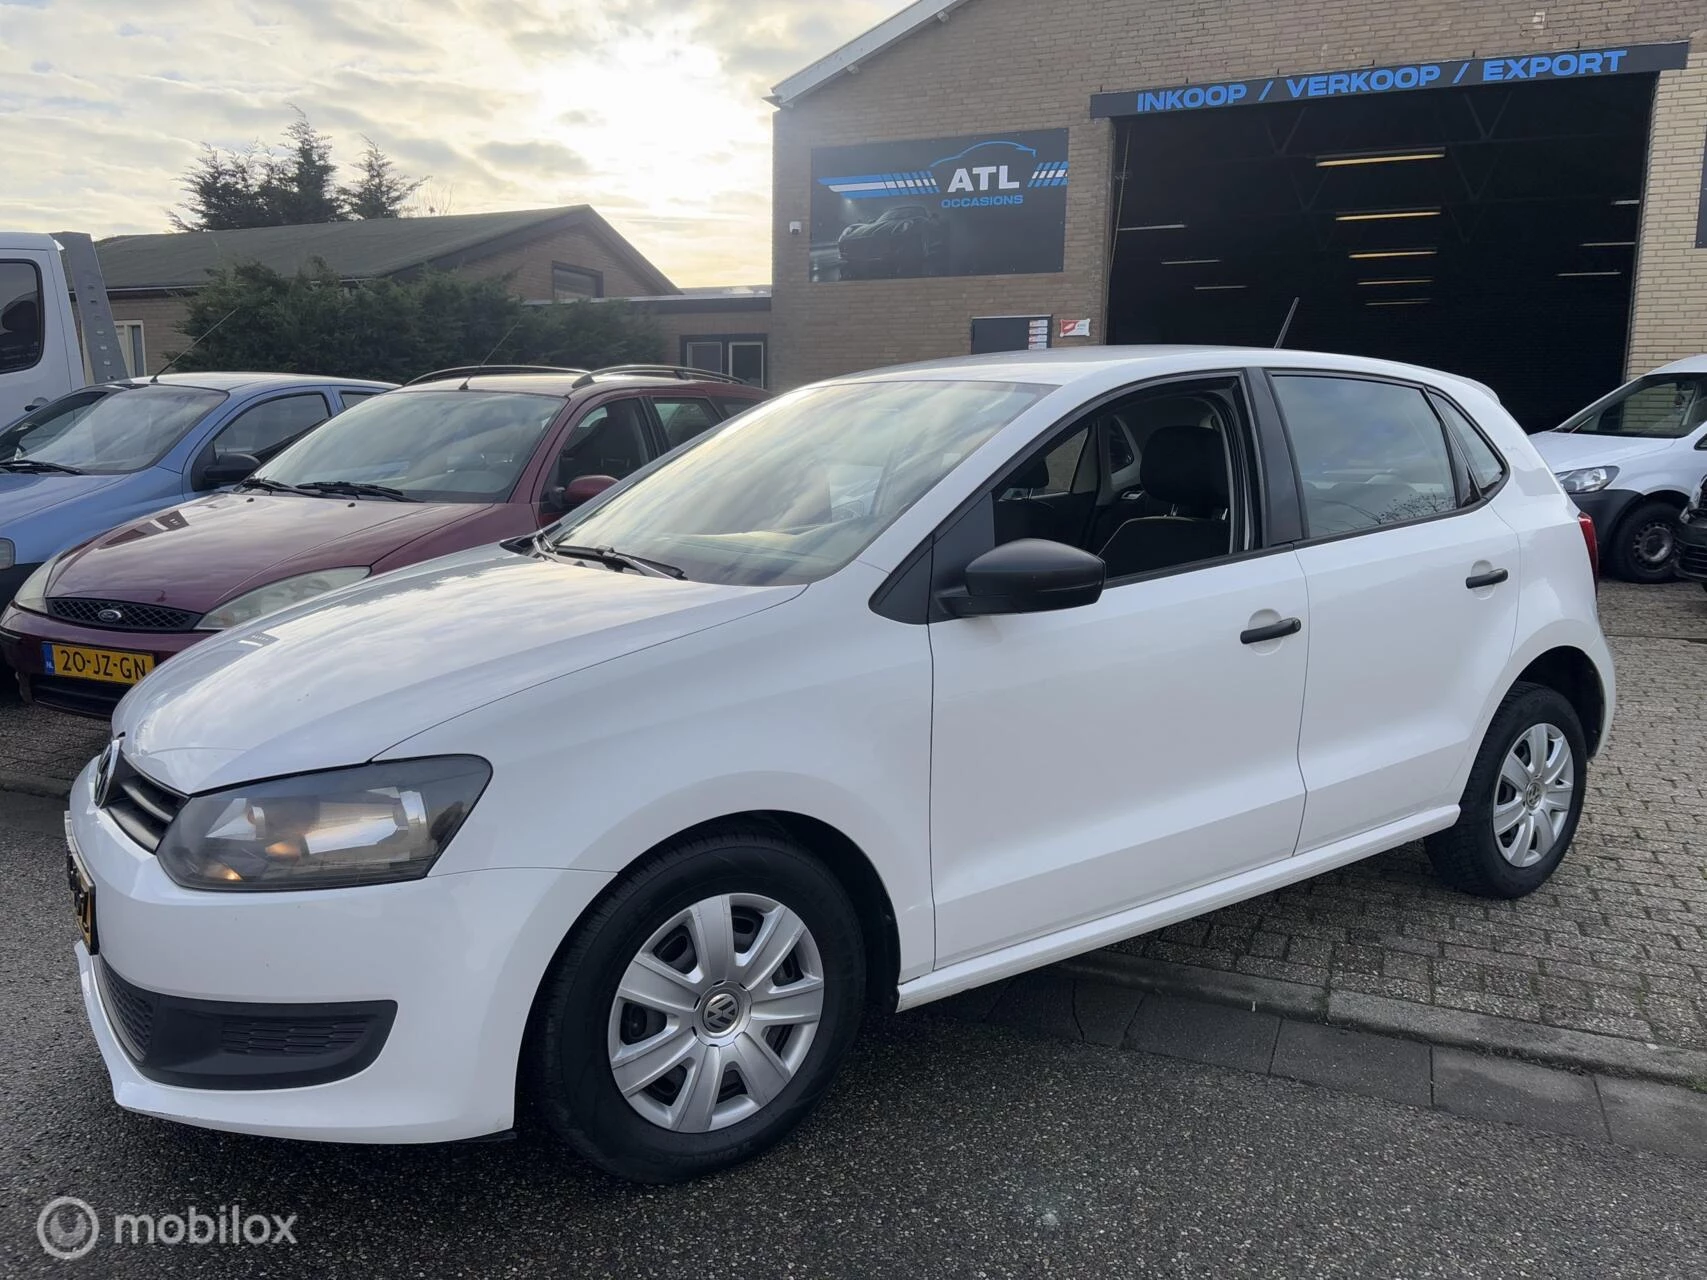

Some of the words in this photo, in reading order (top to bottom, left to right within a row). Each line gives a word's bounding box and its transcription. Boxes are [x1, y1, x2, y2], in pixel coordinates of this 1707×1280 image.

[1136, 84, 1247, 112] INKOOP
[1286, 65, 1440, 98] VERKOOP
[1482, 50, 1627, 82] EXPORT
[947, 165, 1020, 193] ATL
[940, 194, 1024, 208] OCCASIONS
[60, 650, 146, 680] 20-JZ-GN
